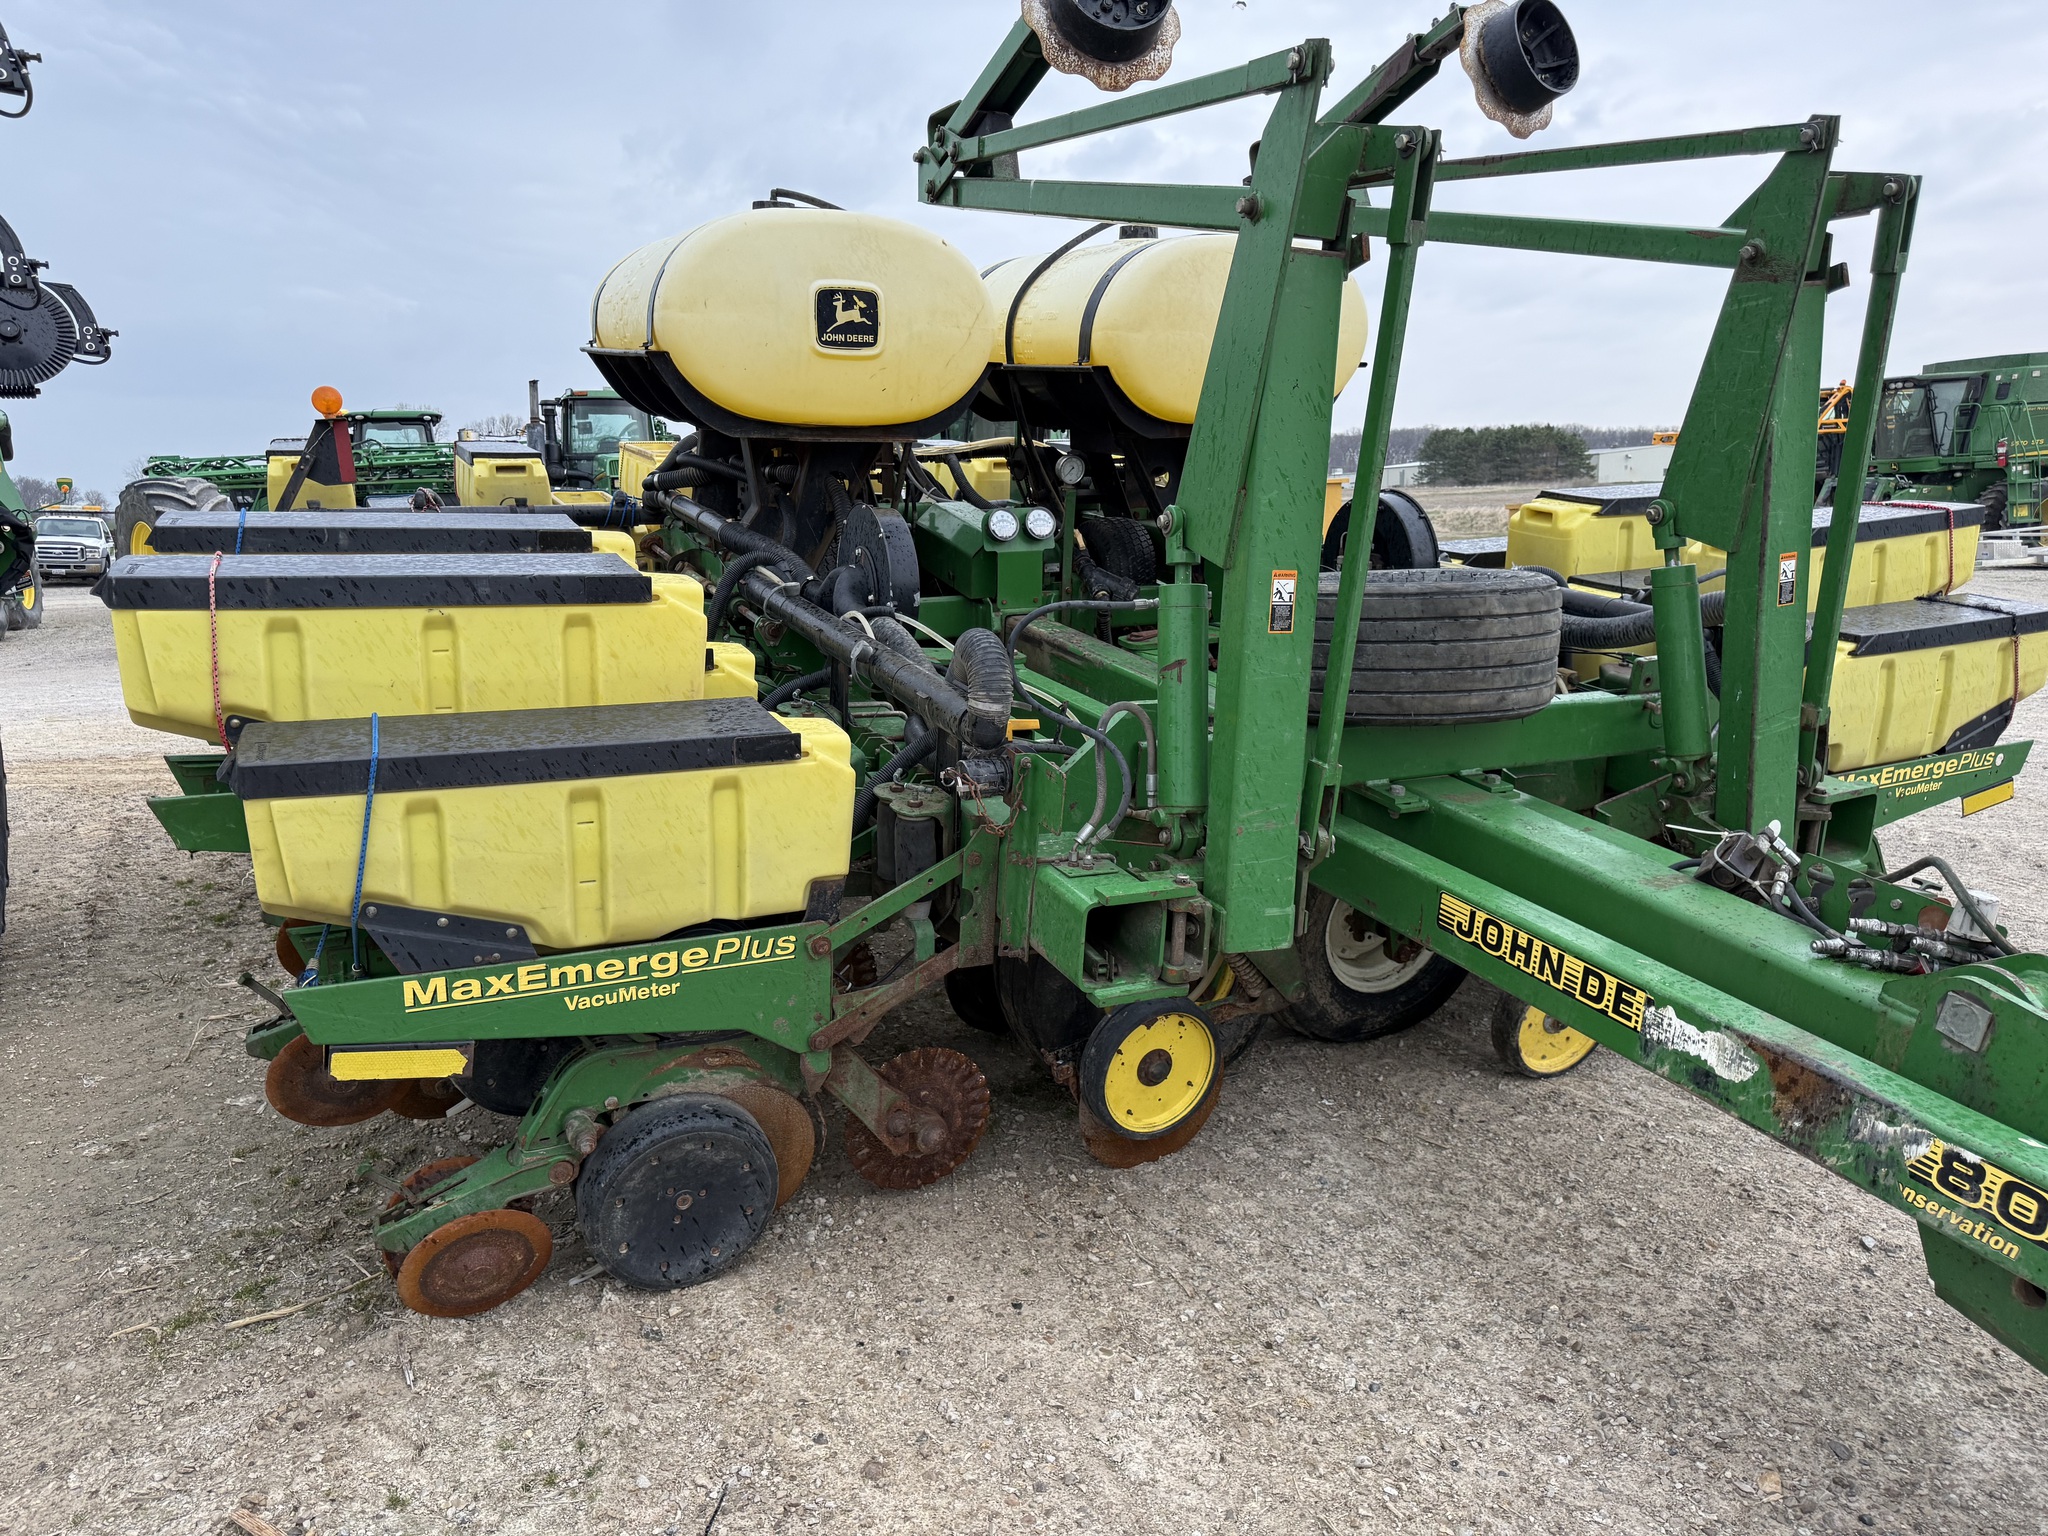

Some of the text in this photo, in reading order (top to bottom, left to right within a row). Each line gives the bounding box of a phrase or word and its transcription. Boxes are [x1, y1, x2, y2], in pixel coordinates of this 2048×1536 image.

[821, 333, 875, 343] JOHN DEERE
[402, 934, 798, 1008] MaxEmergePlus
[1454, 908, 1568, 990] JOHN
[564, 980, 681, 1011] VacuMeter
